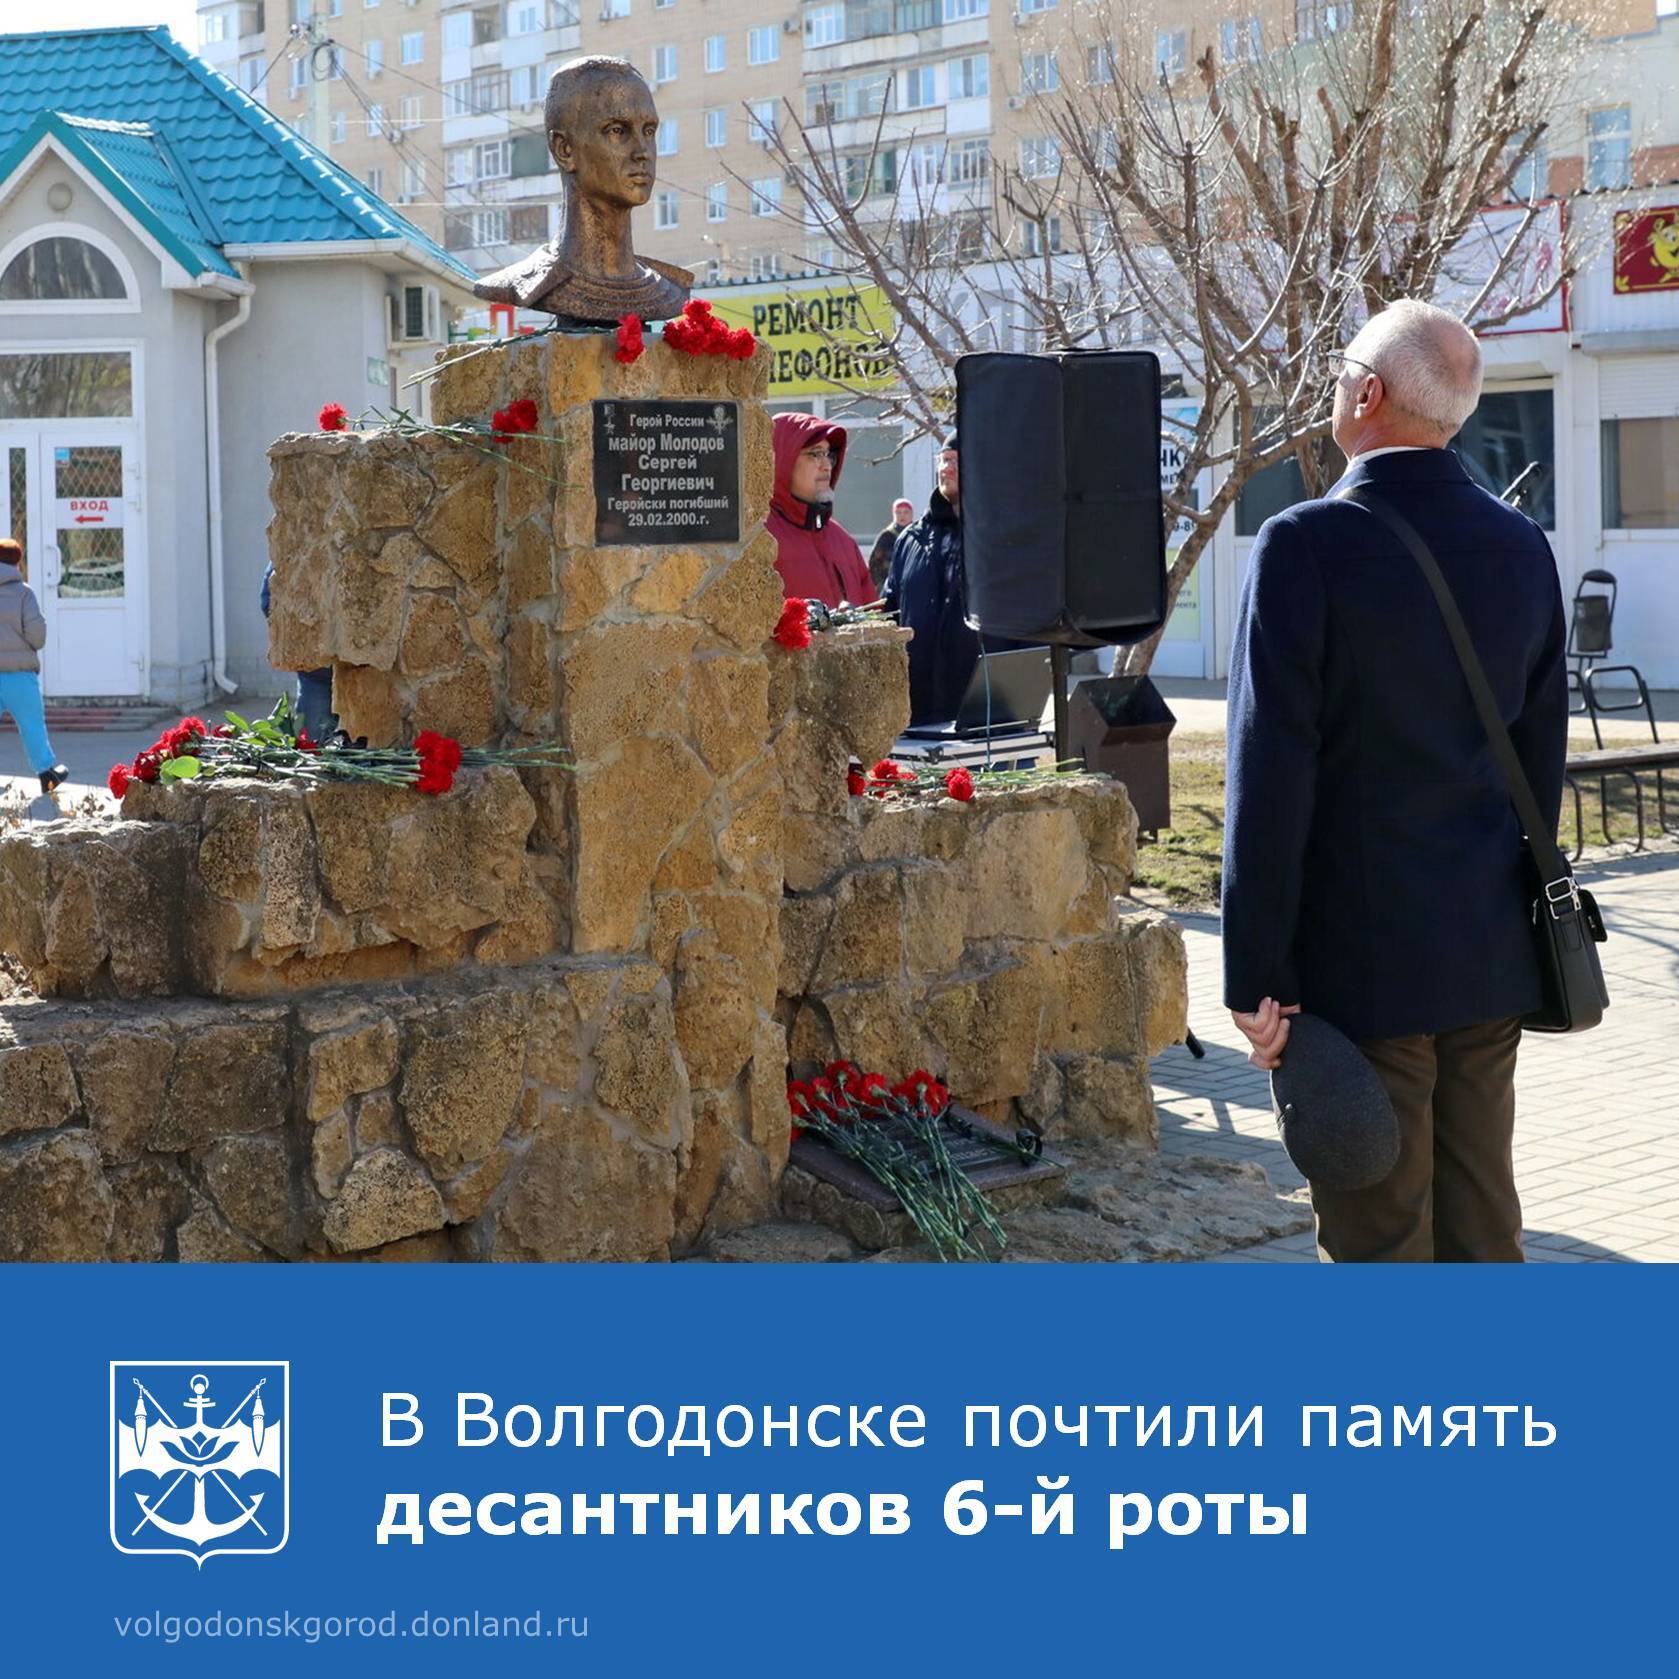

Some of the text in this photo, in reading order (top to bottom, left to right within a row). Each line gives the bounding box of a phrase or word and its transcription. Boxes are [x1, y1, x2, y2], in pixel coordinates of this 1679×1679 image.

[753, 295, 861, 336] РЕМОНТ
[630, 414, 705, 429] Герой России
[608, 433, 725, 455] майор Молодов
[638, 454, 697, 472] Сергей
[621, 474, 714, 495] Георгиевич
[70, 501, 109, 511] ВХОД
[608, 496, 729, 513] Геройски погибший
[628, 512, 710, 527] 29.02.2000.г.
